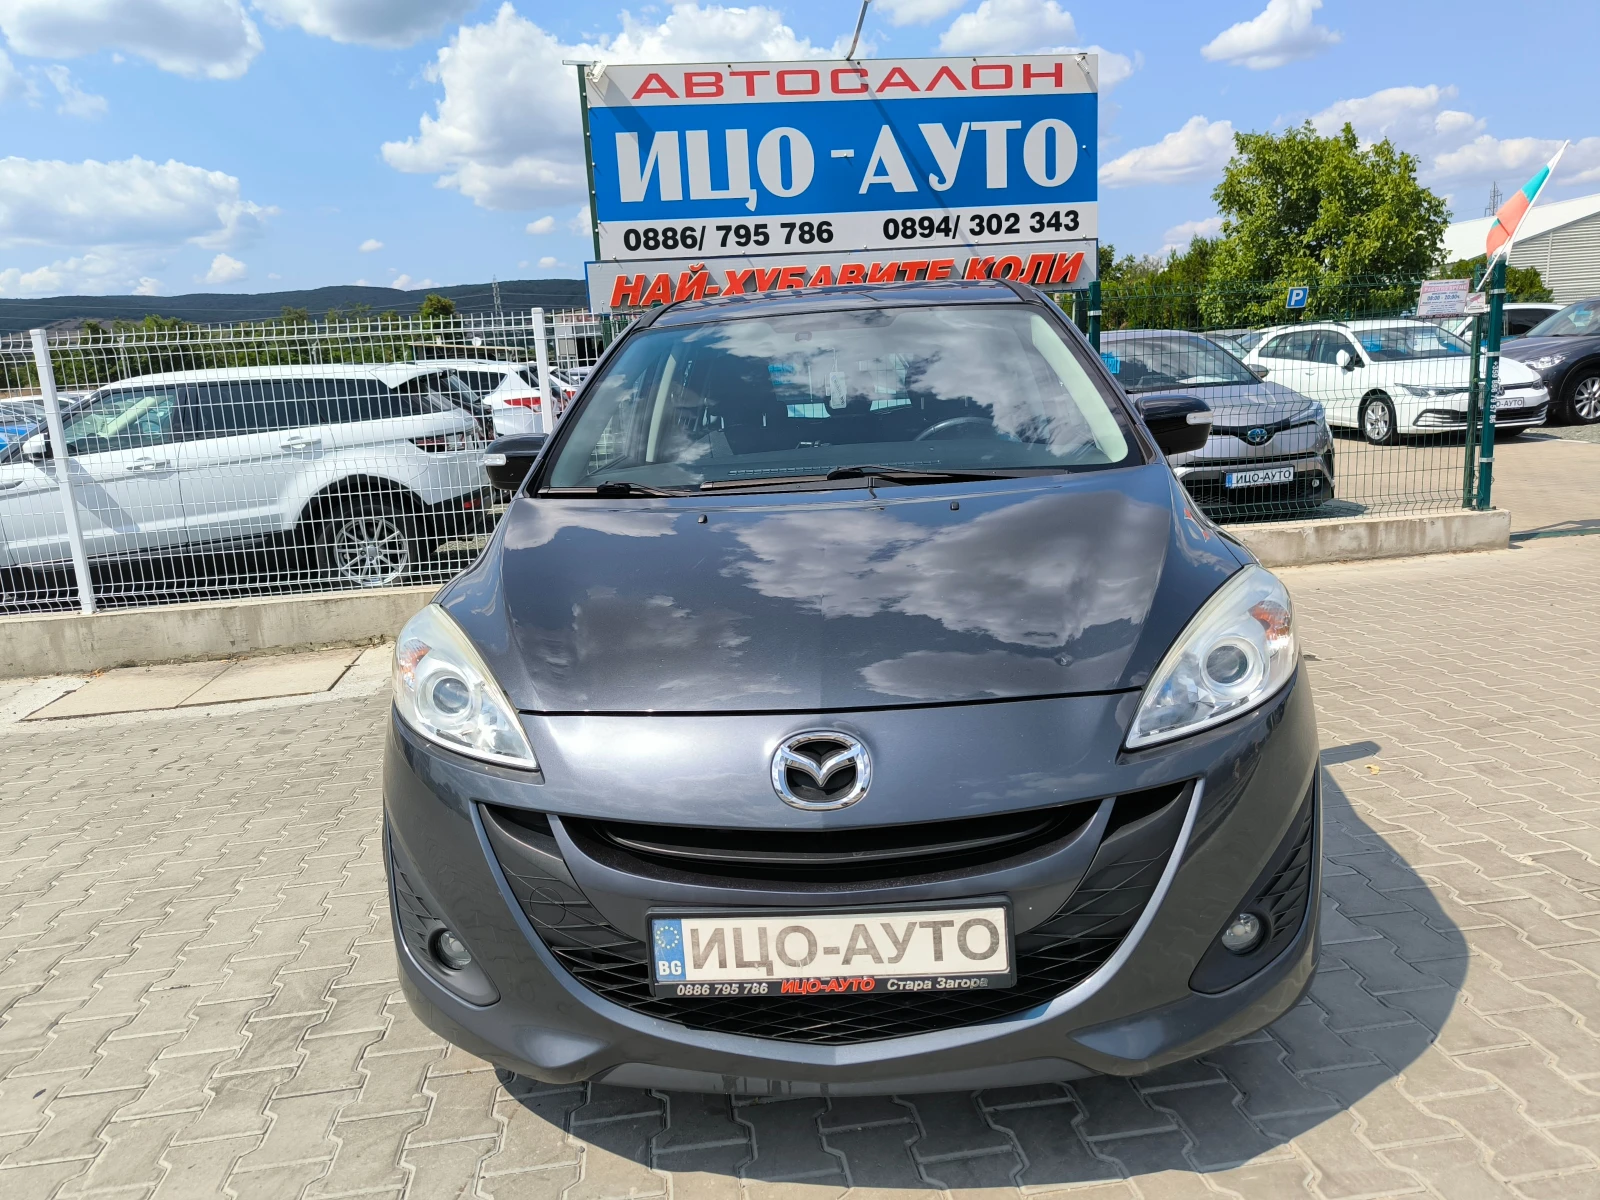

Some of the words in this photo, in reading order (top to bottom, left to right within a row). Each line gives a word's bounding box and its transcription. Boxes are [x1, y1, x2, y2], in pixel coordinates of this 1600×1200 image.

[631, 62, 1064, 100] АВТОСАЛОН
[623, 225, 707, 252] 0886/
[716, 222, 770, 248] 795
[780, 220, 835, 245] 786
[882, 214, 960, 241] 0894/
[968, 211, 1021, 236] 302
[1030, 209, 1081, 234] 343
[609, 258, 955, 307] НАЙ-ХУБАВИТЕ
[963, 251, 1085, 285] КОЛИ
[1291, 289, 1304, 306] P
[1236, 470, 1292, 484] ИЦО-АУТО
[689, 918, 1001, 977] ИЦО-АУТО
[658, 960, 682, 976] BG
[676, 984, 710, 996] 0886
[714, 983, 739, 995] 795
[743, 982, 769, 994] 786
[780, 977, 875, 995] ИЦО-АУТО
[886, 978, 932, 992] Стара
[935, 977, 989, 990] Загора
